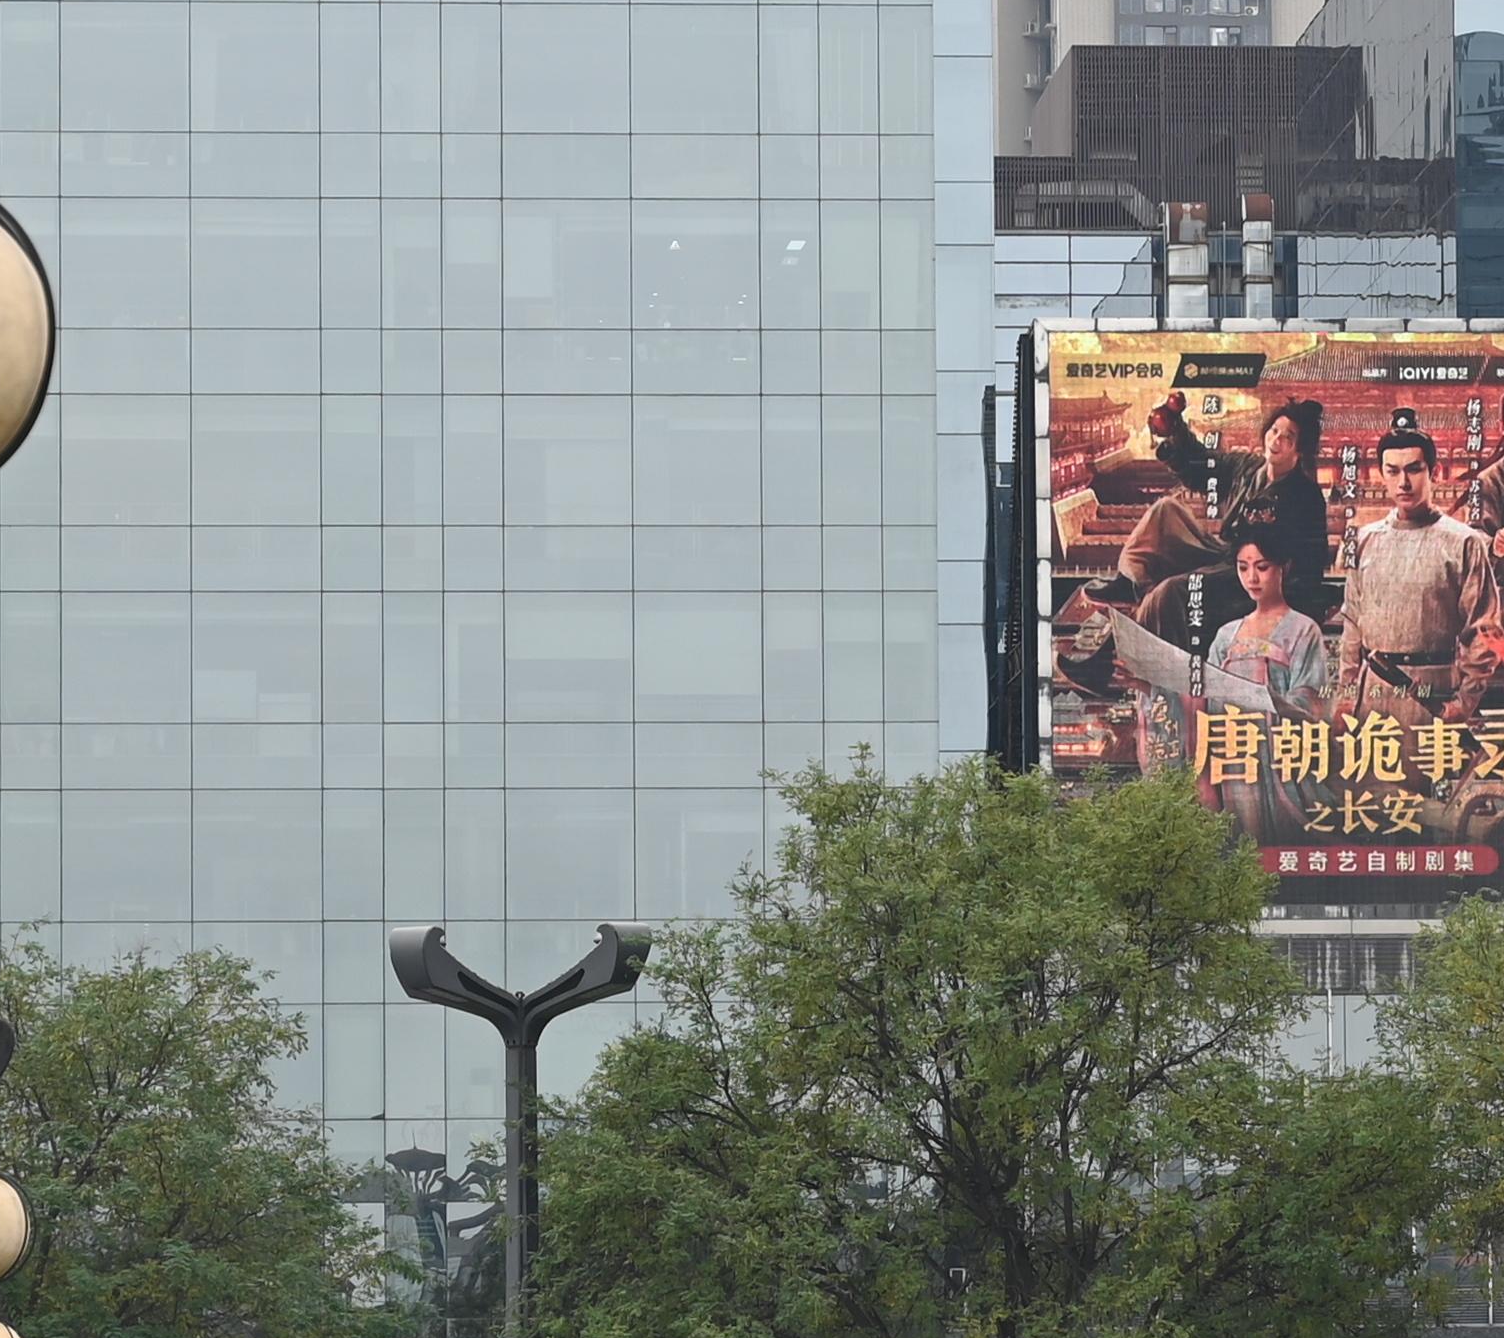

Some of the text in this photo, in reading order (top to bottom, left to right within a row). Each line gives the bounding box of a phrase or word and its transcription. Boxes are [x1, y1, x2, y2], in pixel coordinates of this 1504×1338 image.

[1066, 363, 1164, 379] 爱奇艺VIP会员
[1398, 367, 1435, 379] iQIYI
[1466, 398, 1483, 451] 杨志刚
[1342, 445, 1357, 499] 杨旭文
[1302, 788, 1426, 836] 之长安
[1278, 849, 1475, 874] 爱奇艺自制剧集
